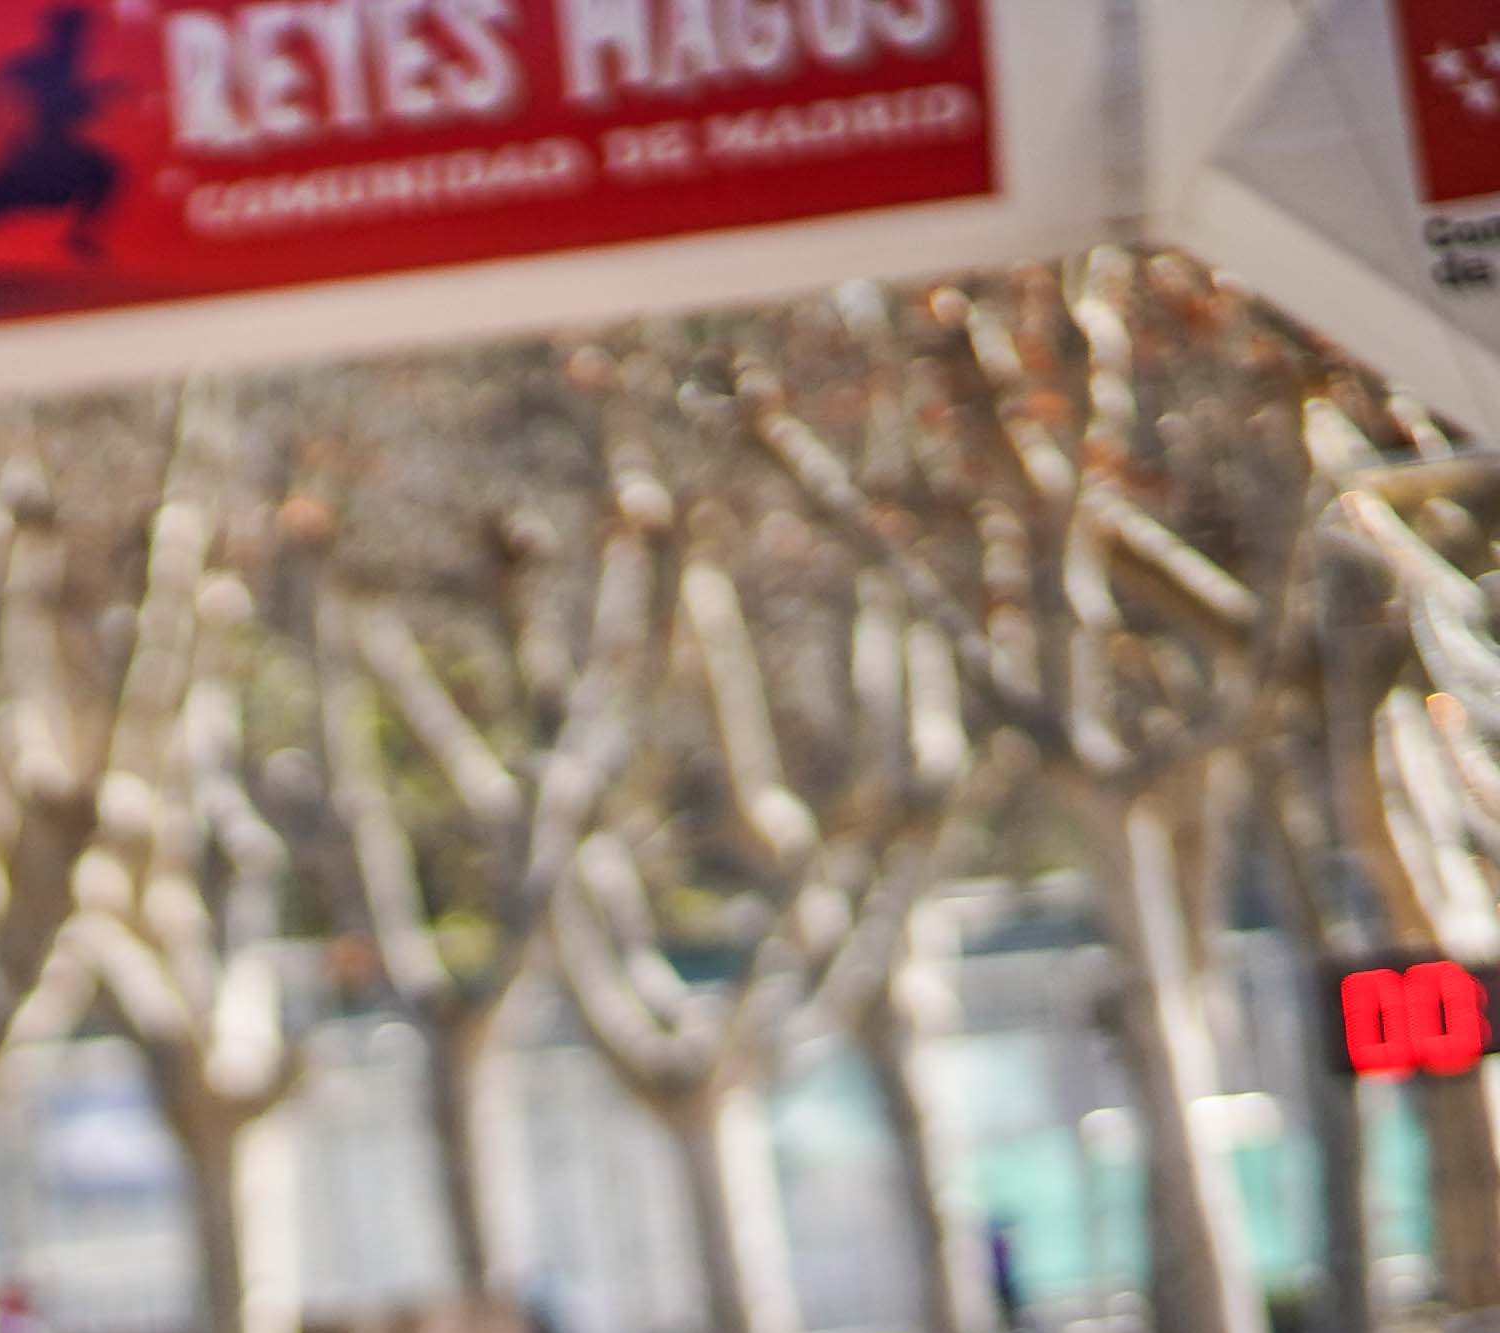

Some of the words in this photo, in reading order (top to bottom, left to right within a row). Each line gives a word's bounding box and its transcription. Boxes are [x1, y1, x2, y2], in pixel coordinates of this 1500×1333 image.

[164, 0, 520, 146] REYES
[602, 125, 697, 178] DE
[703, 84, 975, 160] MADRID
